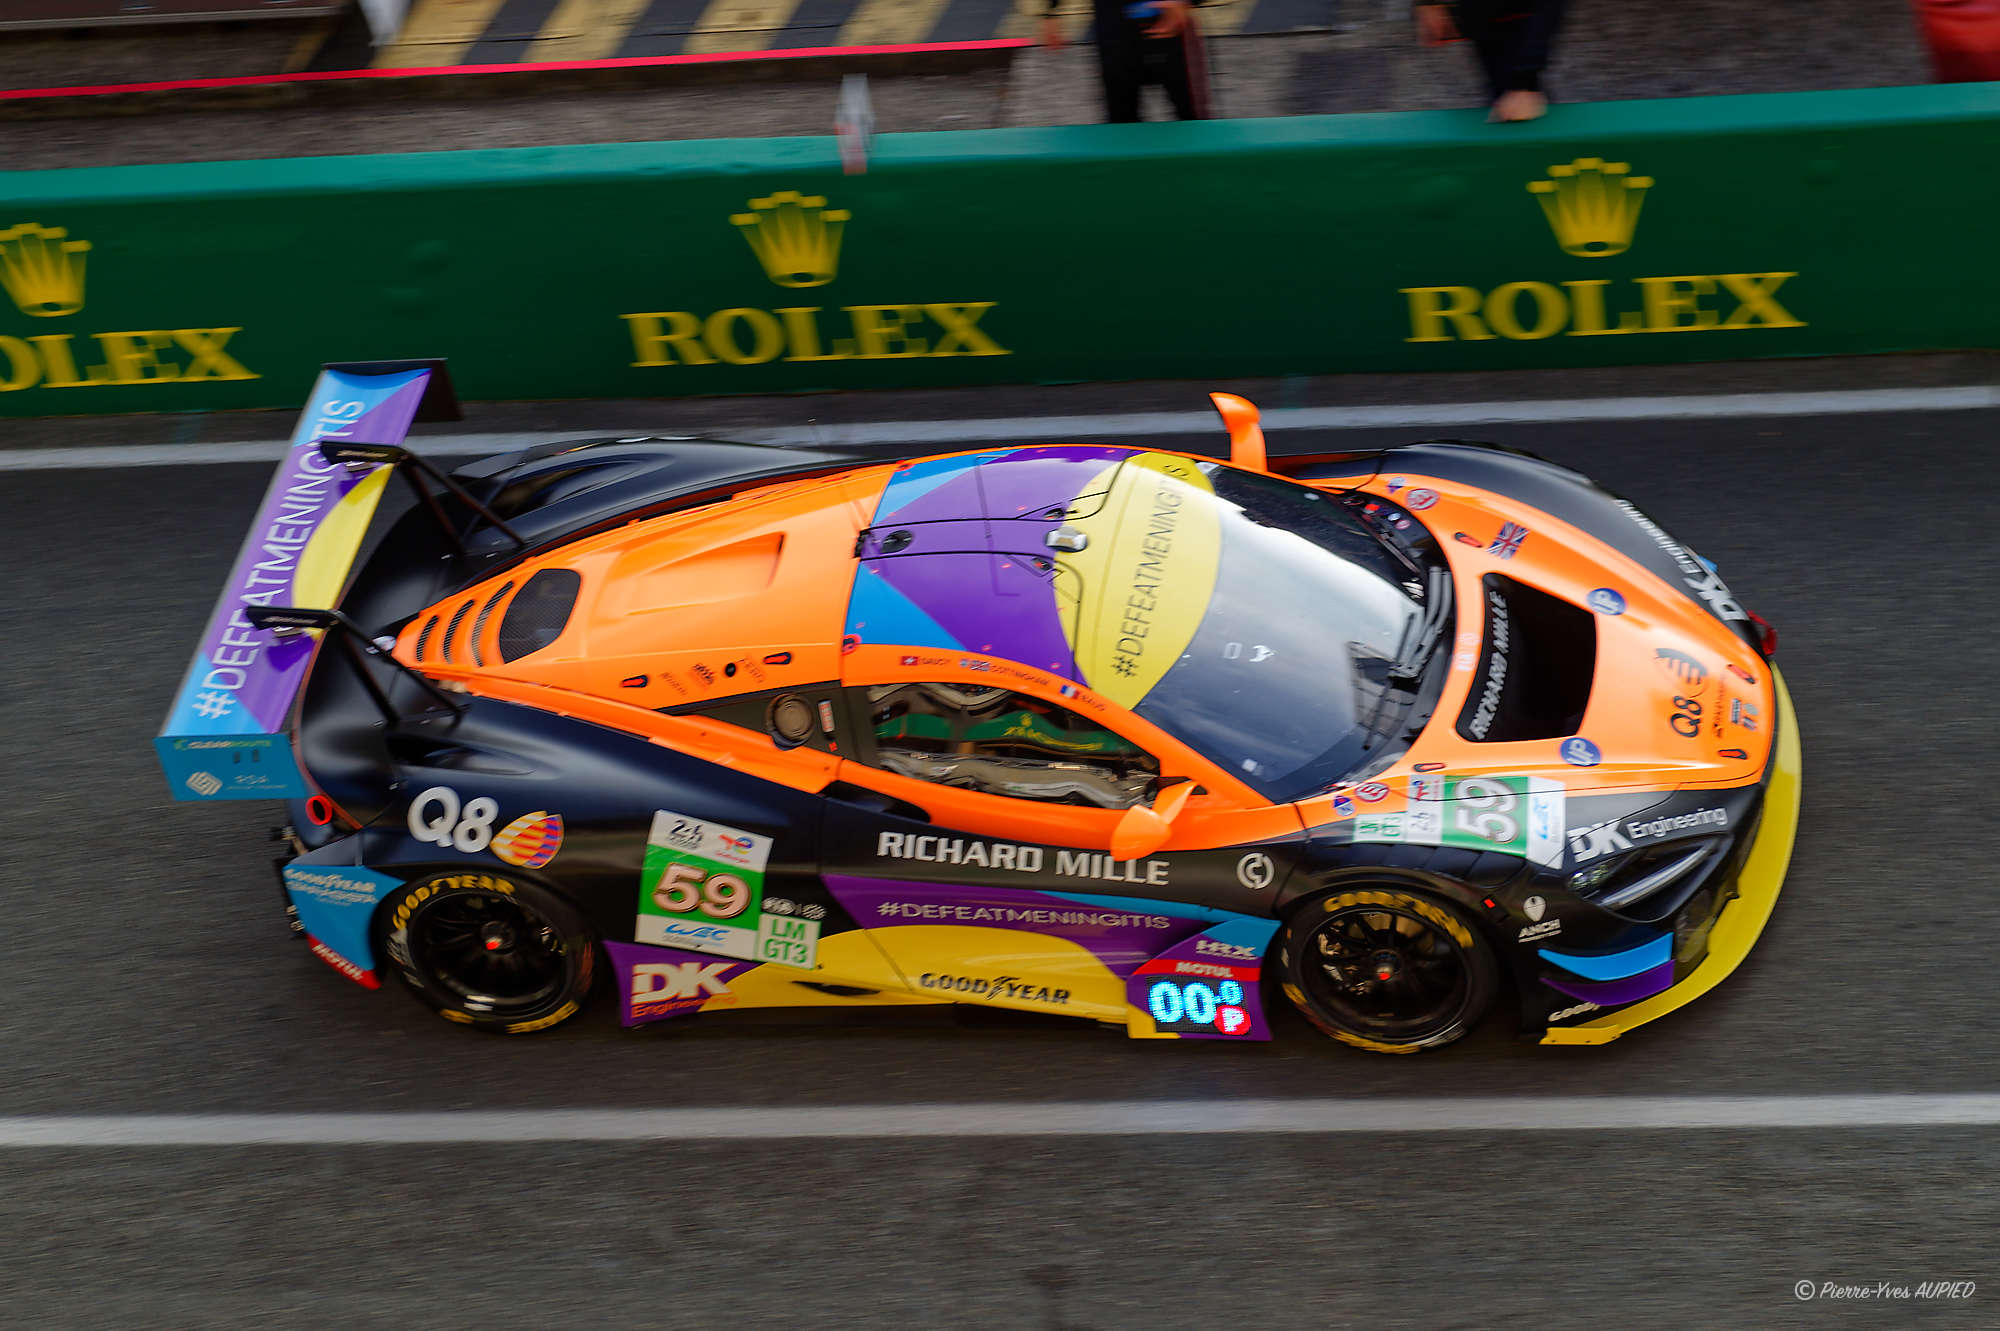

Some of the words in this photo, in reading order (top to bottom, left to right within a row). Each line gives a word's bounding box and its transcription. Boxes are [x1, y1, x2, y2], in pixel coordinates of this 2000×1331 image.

[619, 301, 1013, 367] ROLEX
[1398, 271, 1809, 342] ROLEX
[192, 399, 366, 720] #DEFATMENINGTIS
[1110, 462, 1190, 679] #DEFEATMENINGIIS
[1469, 652, 1508, 739] RICHARD
[1490, 590, 1510, 653] MILLE
[1670, 695, 1702, 738] Q8
[407, 786, 499, 853] Q8
[1454, 777, 1519, 844] 59
[1567, 818, 1634, 862] DK
[1626, 807, 1728, 839] Engineering
[877, 830, 1043, 873] RICHARD
[1055, 849, 1170, 886] MILLE
[653, 862, 752, 919] 59
[878, 901, 1170, 930] #DEFEATMENINGITIS
[665, 922, 731, 942] WEC
[764, 938, 809, 964] GT3
[771, 918, 806, 940] LM
[312, 942, 365, 982] MOTUL
[631, 961, 739, 1005] DK
[1175, 961, 1234, 979] MOTUL
